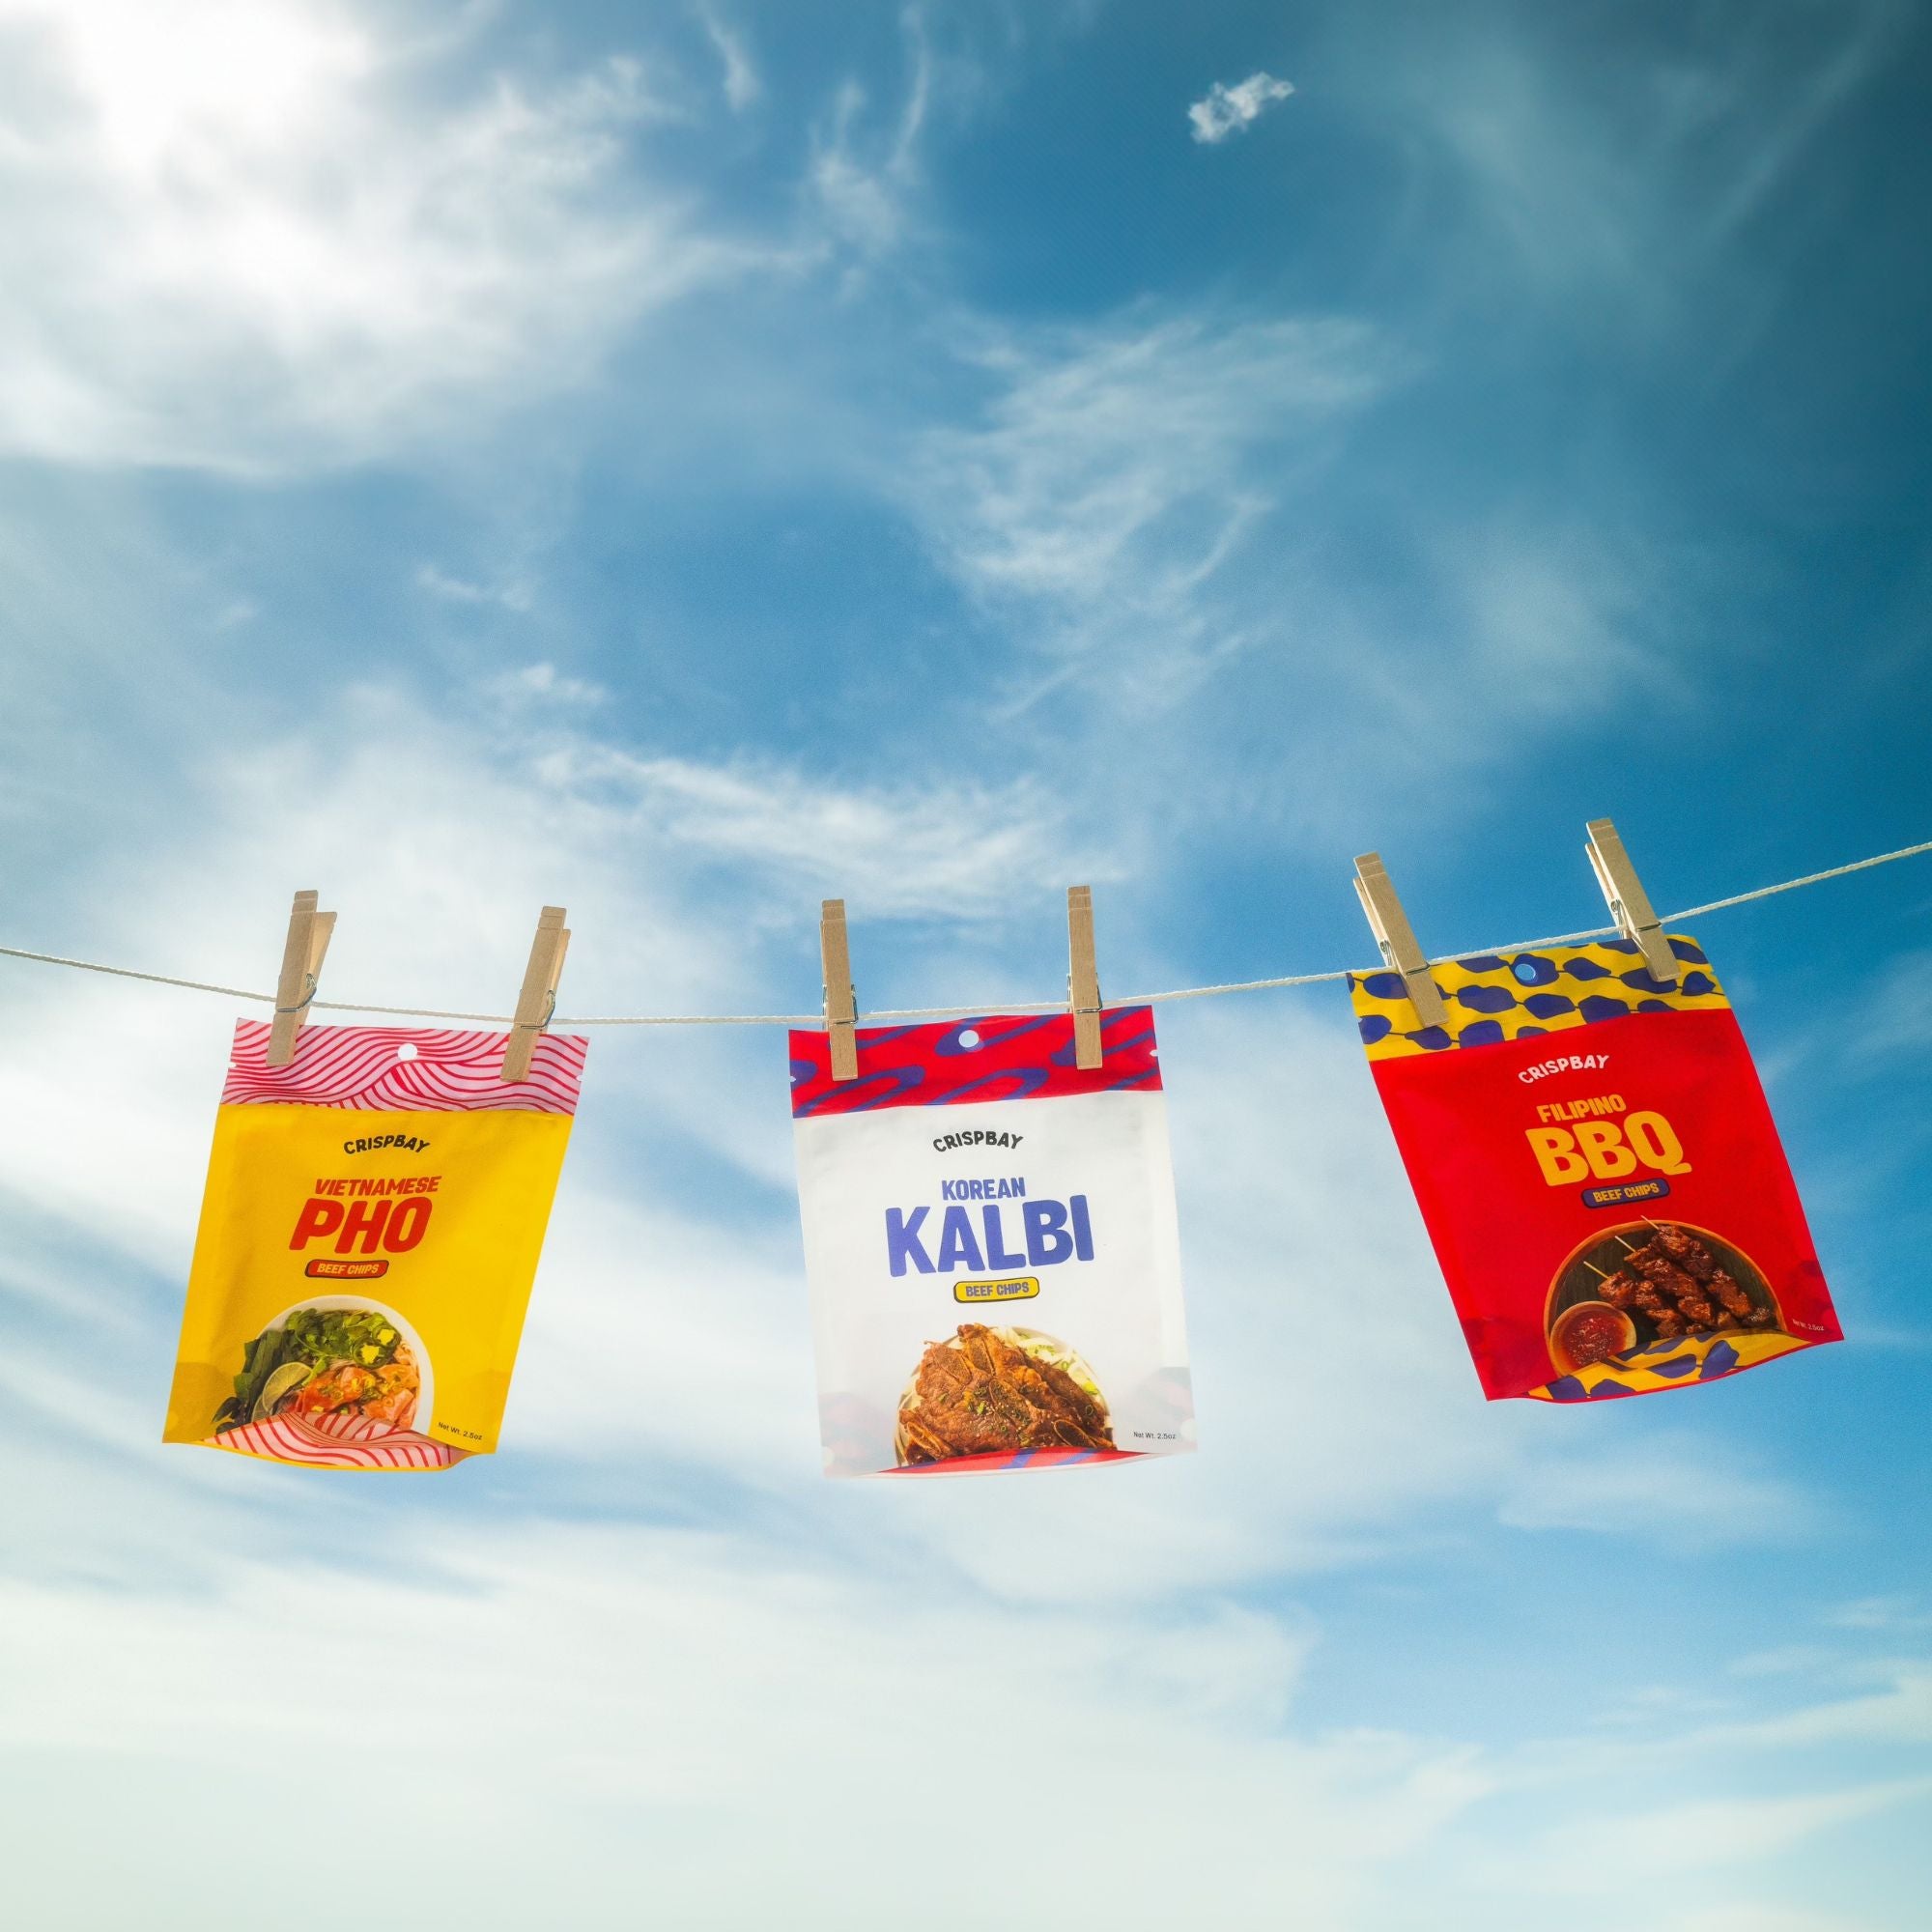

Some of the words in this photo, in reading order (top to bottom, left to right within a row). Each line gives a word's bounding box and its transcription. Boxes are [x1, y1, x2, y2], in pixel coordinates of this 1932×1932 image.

[1518, 1055, 1609, 1084] CRISPBAY
[1536, 1094, 1627, 1123] FILIPINO
[344, 1134, 431, 1154] CRISPBAY
[932, 1130, 1024, 1152] CRISPBAY
[1524, 1111, 1692, 1187] BBQ
[315, 1176, 442, 1196] VIETNAMESE
[942, 1177, 1027, 1201] KOREAN
[1593, 1188, 1622, 1203] BEEF
[1624, 1182, 1660, 1198] CHIPS
[289, 1197, 433, 1254] PHO
[885, 1194, 1094, 1277] KALBI
[316, 1263, 346, 1274] BEEF
[347, 1264, 380, 1275] CHIPS
[965, 1285, 994, 1297] BEEF
[996, 1282, 1030, 1296] CHIPS
[463, 1431, 483, 1440] 2.5oz
